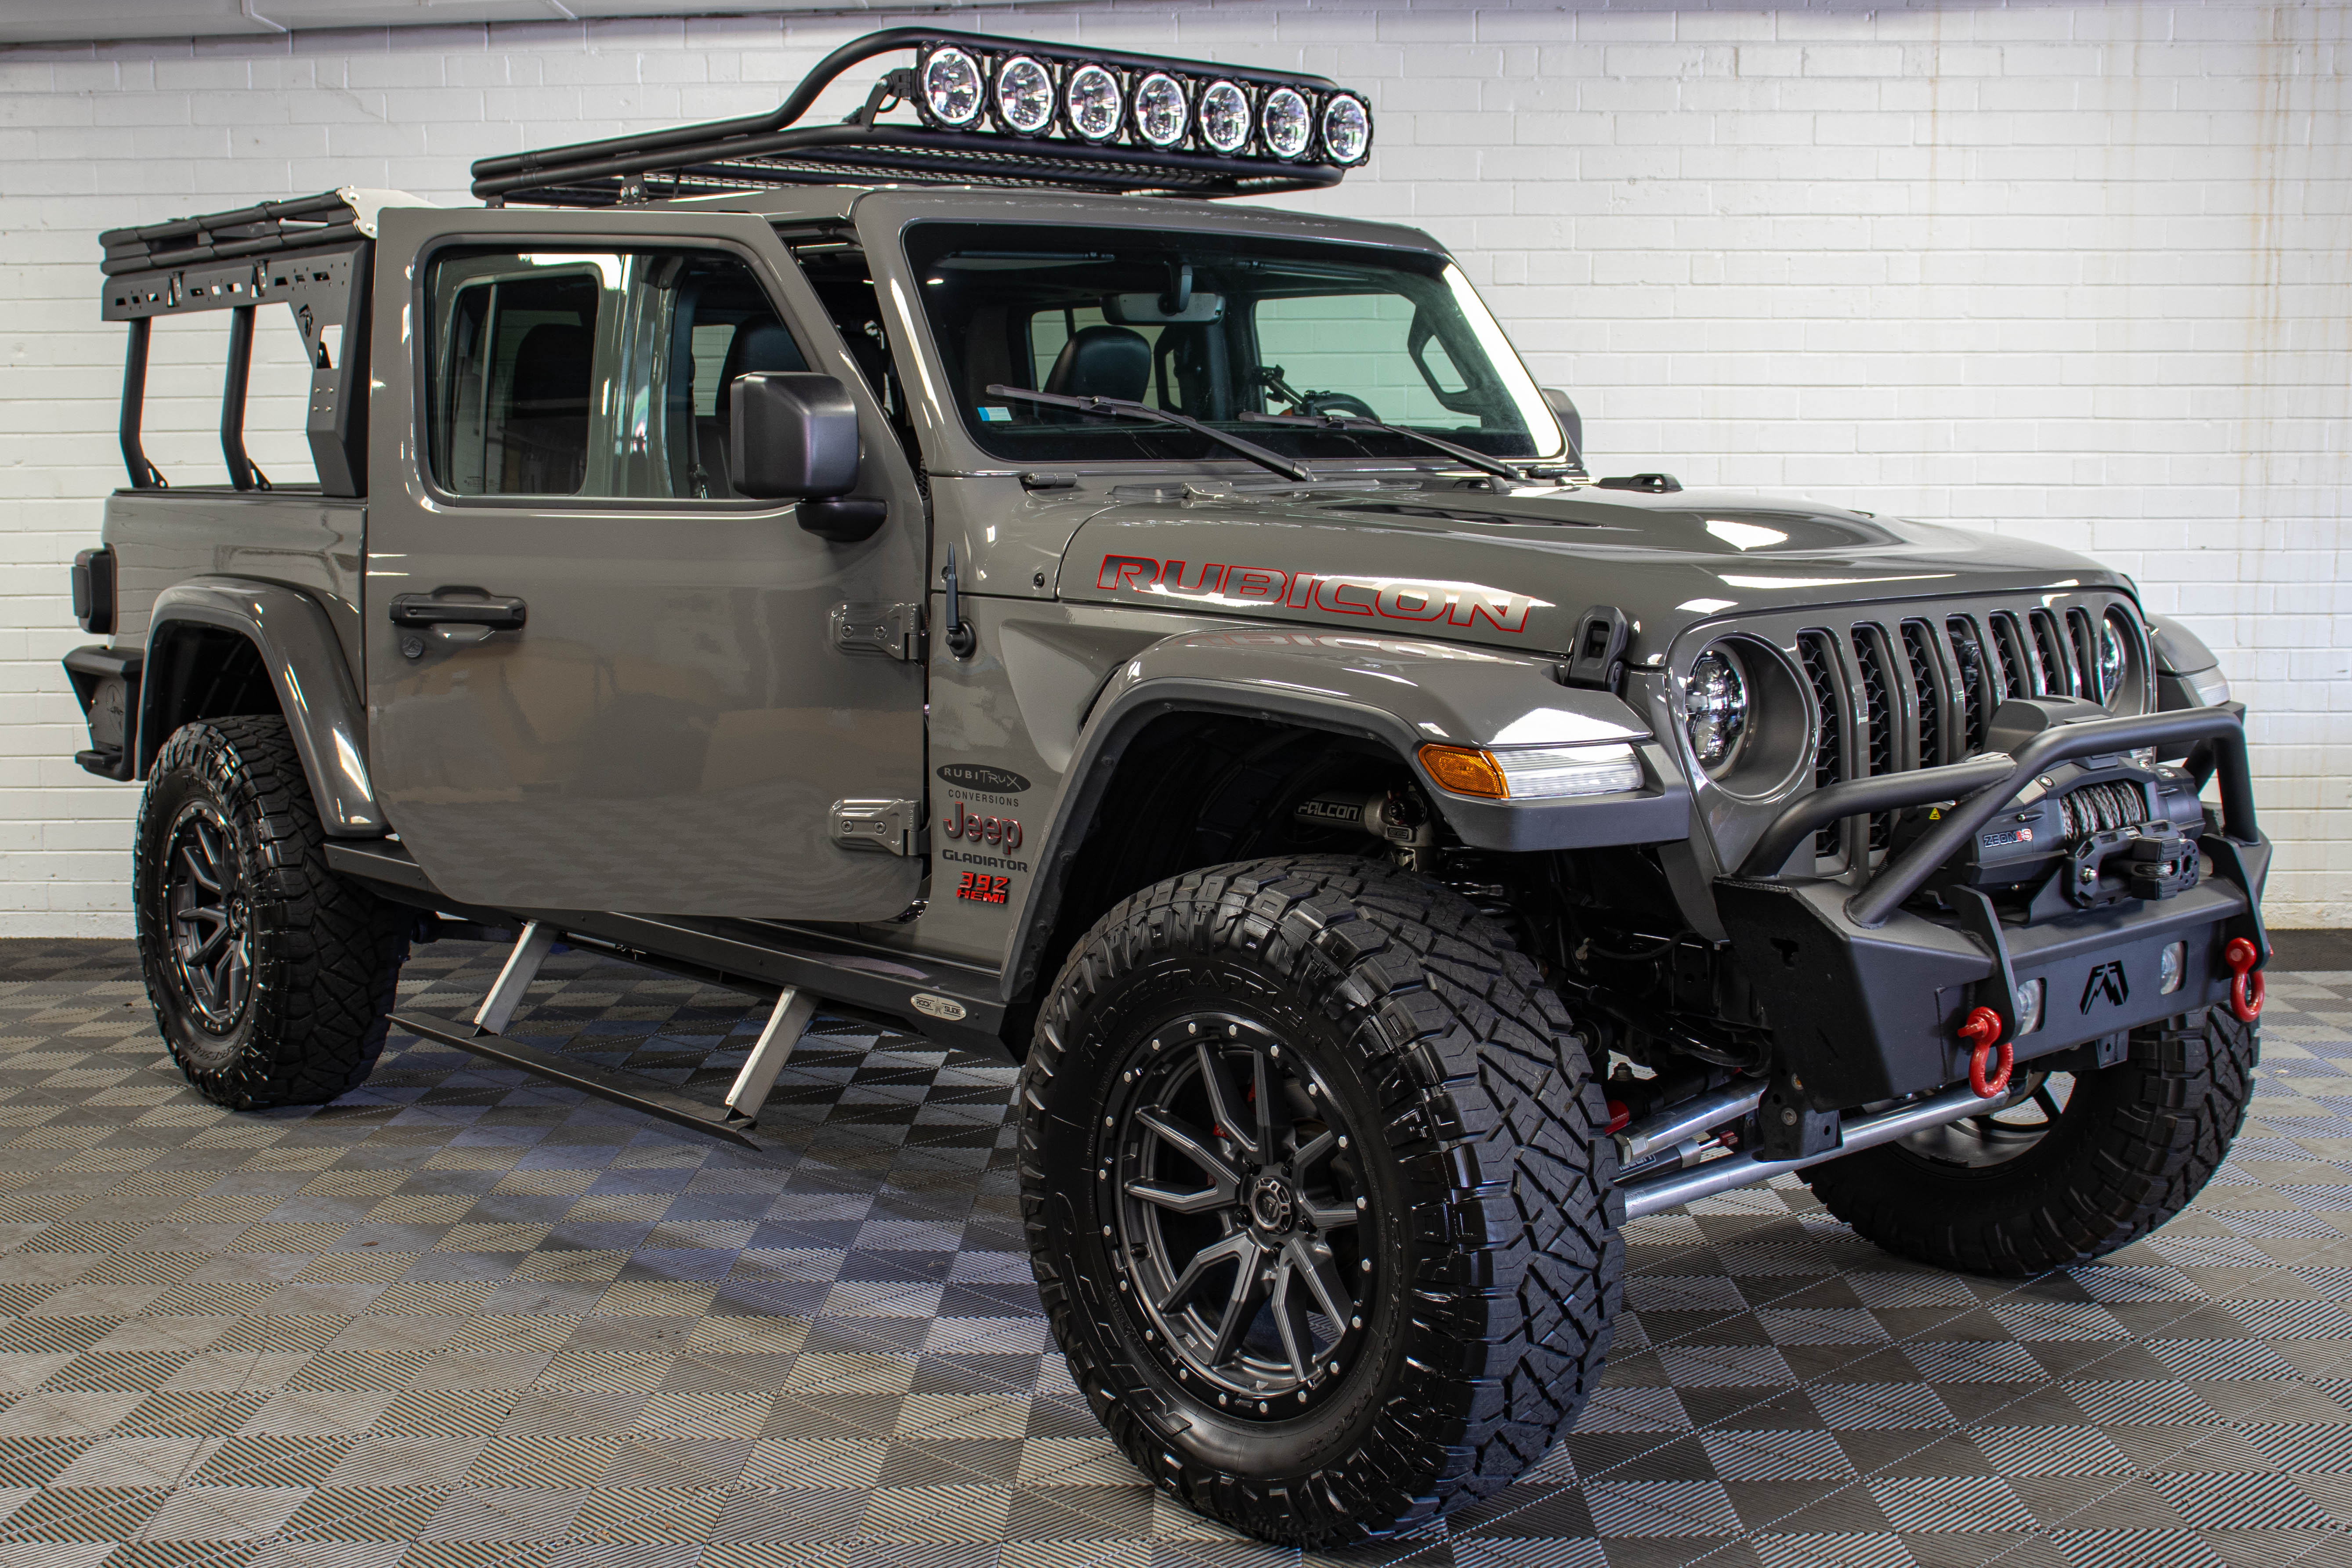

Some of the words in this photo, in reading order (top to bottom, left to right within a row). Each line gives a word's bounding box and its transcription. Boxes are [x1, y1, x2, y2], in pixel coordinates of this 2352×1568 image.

[1096, 554, 1531, 633] RUBICON
[948, 789, 1019, 807] CONVERSIONS
[942, 801, 1023, 855] Jeep
[942, 849, 1028, 873] GLADIATOR
[959, 871, 1010, 893] 392
[956, 887, 1007, 904] HEMI
[916, 999, 932, 1008] ROCK
[944, 1006, 961, 1015] SLIDE
